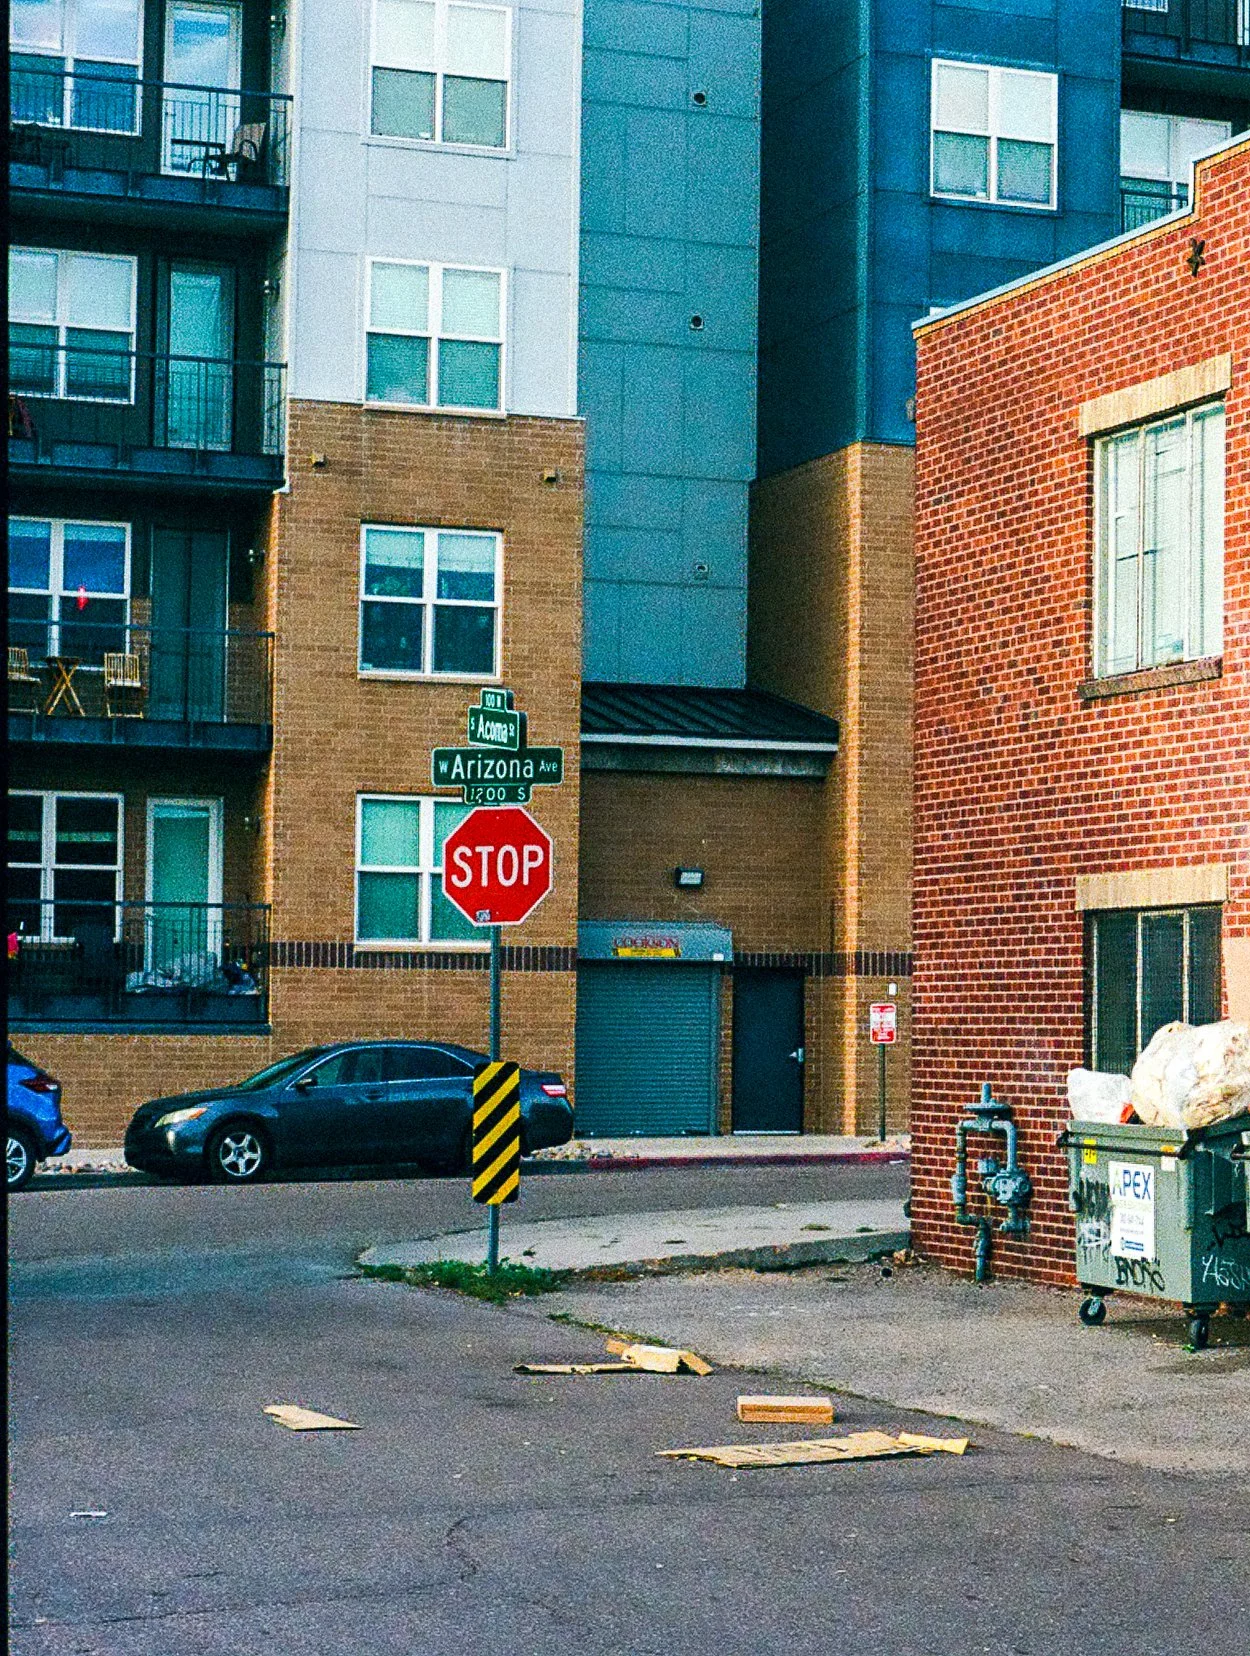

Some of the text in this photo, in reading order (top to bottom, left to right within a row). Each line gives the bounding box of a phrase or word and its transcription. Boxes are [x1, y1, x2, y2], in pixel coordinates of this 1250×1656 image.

[470, 716, 475, 731] S
[477, 713, 508, 743] Acoma
[438, 754, 558, 780] W Arizona Ave
[470, 787, 526, 801] 1200 S
[450, 844, 545, 888] STOP
[1112, 1168, 1151, 1200] APEX
